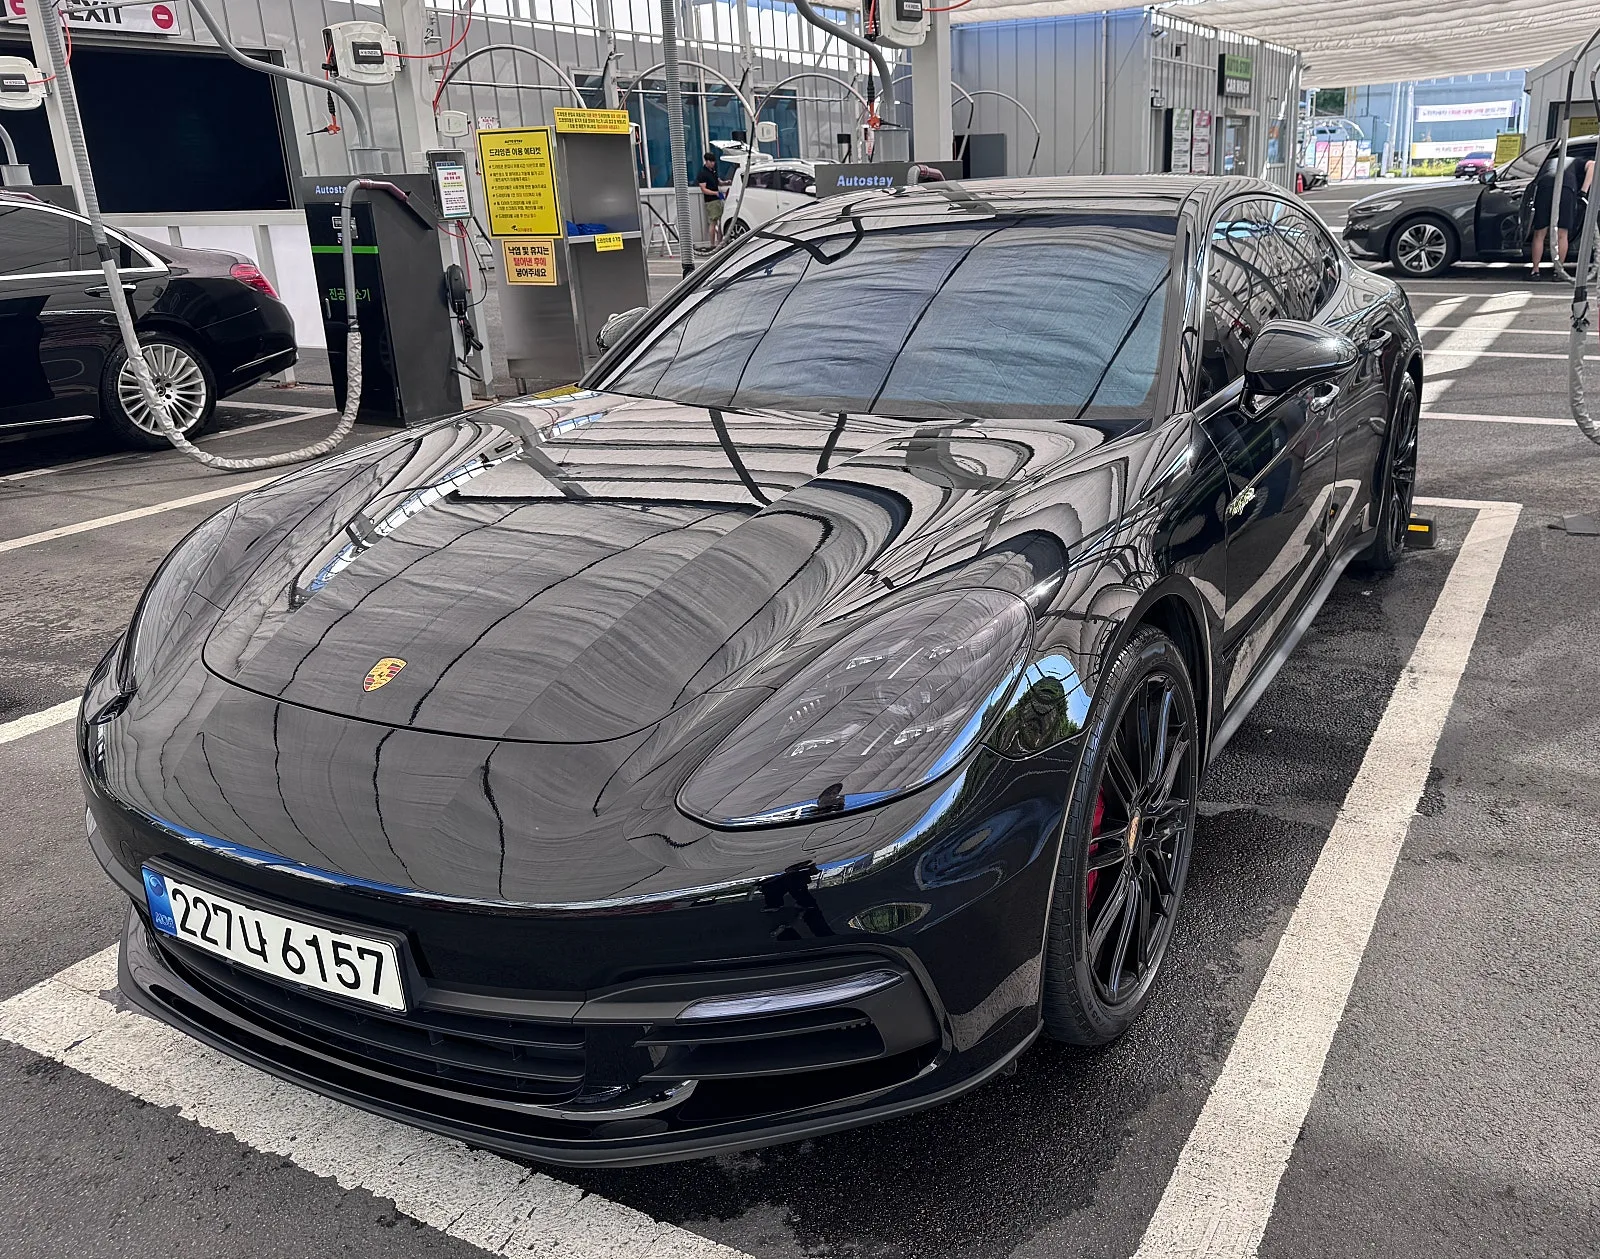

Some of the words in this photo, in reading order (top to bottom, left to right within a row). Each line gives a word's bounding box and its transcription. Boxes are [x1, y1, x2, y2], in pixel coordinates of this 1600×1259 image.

[512, 147, 523, 156] 이용
[524, 146, 542, 155] 에티켓
[836, 175, 894, 187] Autostay
[508, 246, 521, 256] 낙엽
[522, 246, 529, 256] 및
[530, 246, 550, 256] 휴지는
[533, 257, 547, 266] 후에
[515, 268, 547, 278] 넣어주세요
[328, 287, 371, 302] 진공소기
[171, 888, 268, 963] 227나
[281, 927, 384, 996] 6157
